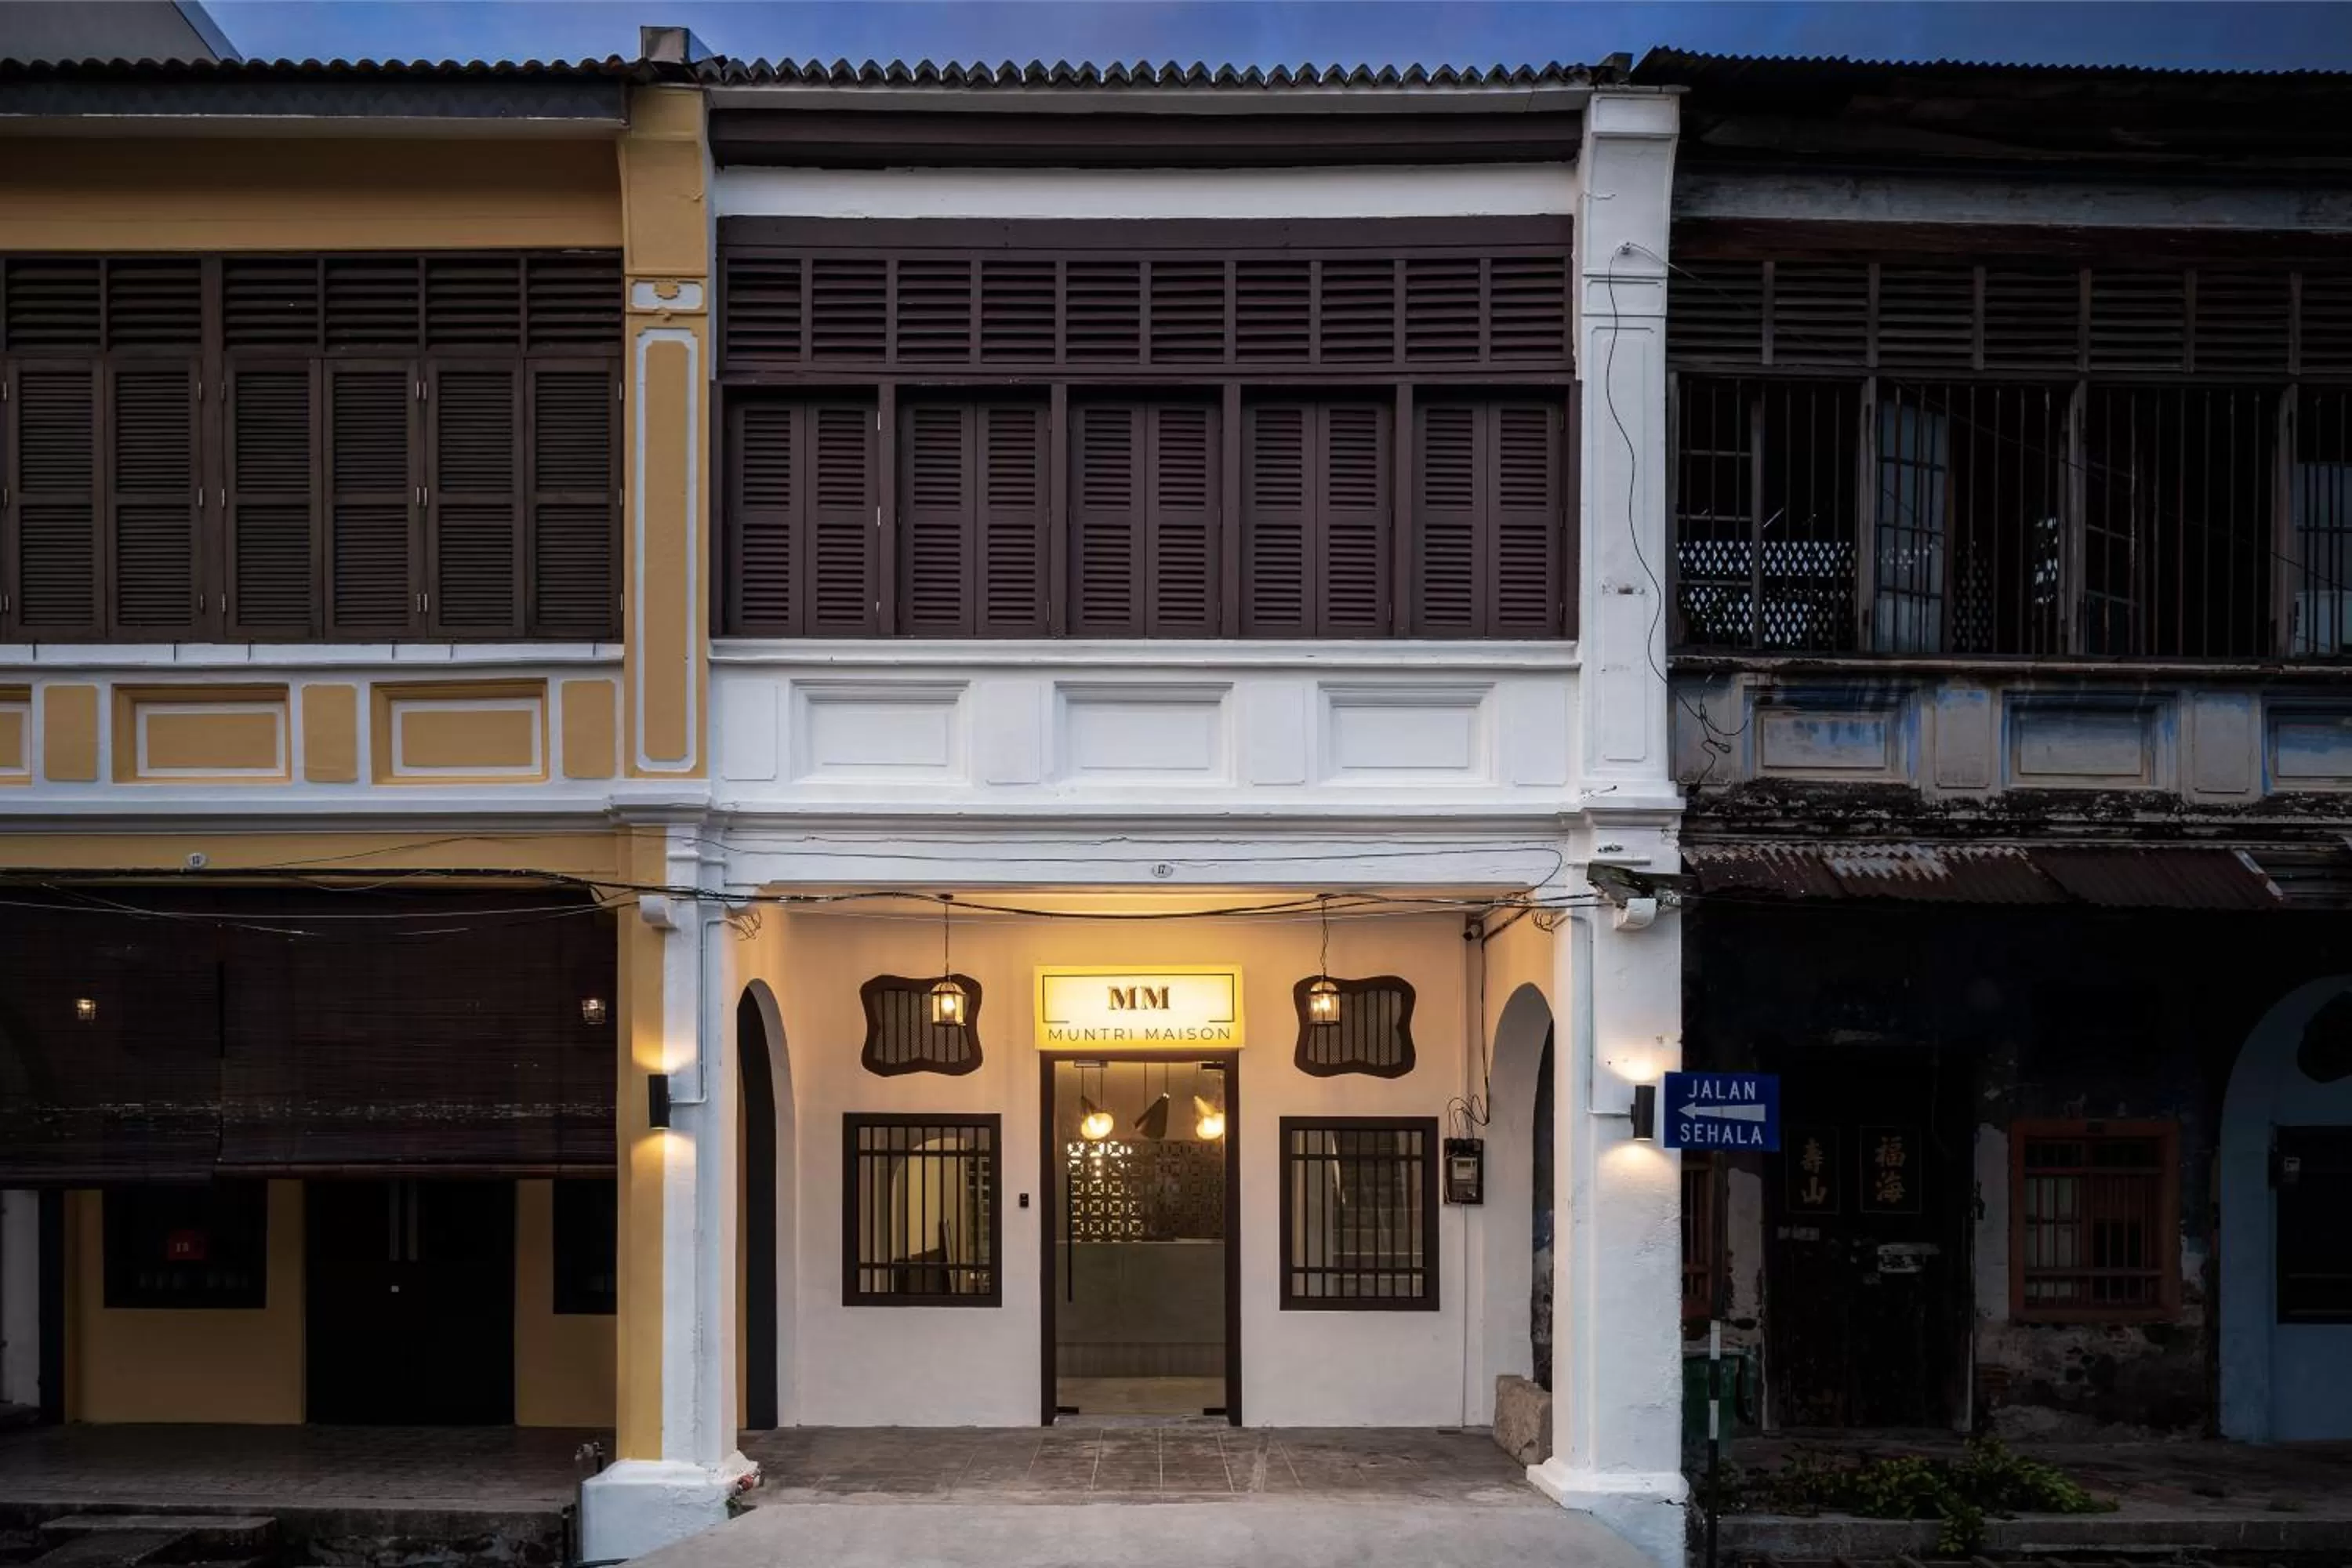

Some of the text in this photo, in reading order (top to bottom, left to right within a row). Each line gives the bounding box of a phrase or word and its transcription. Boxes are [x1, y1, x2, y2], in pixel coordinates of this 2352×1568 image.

[1107, 985, 1171, 1011] MM
[1047, 1027, 1231, 1041] MUNTRI MAISON
[1687, 1079, 1756, 1100] JALAN
[1680, 1123, 1763, 1145] SEHALA
